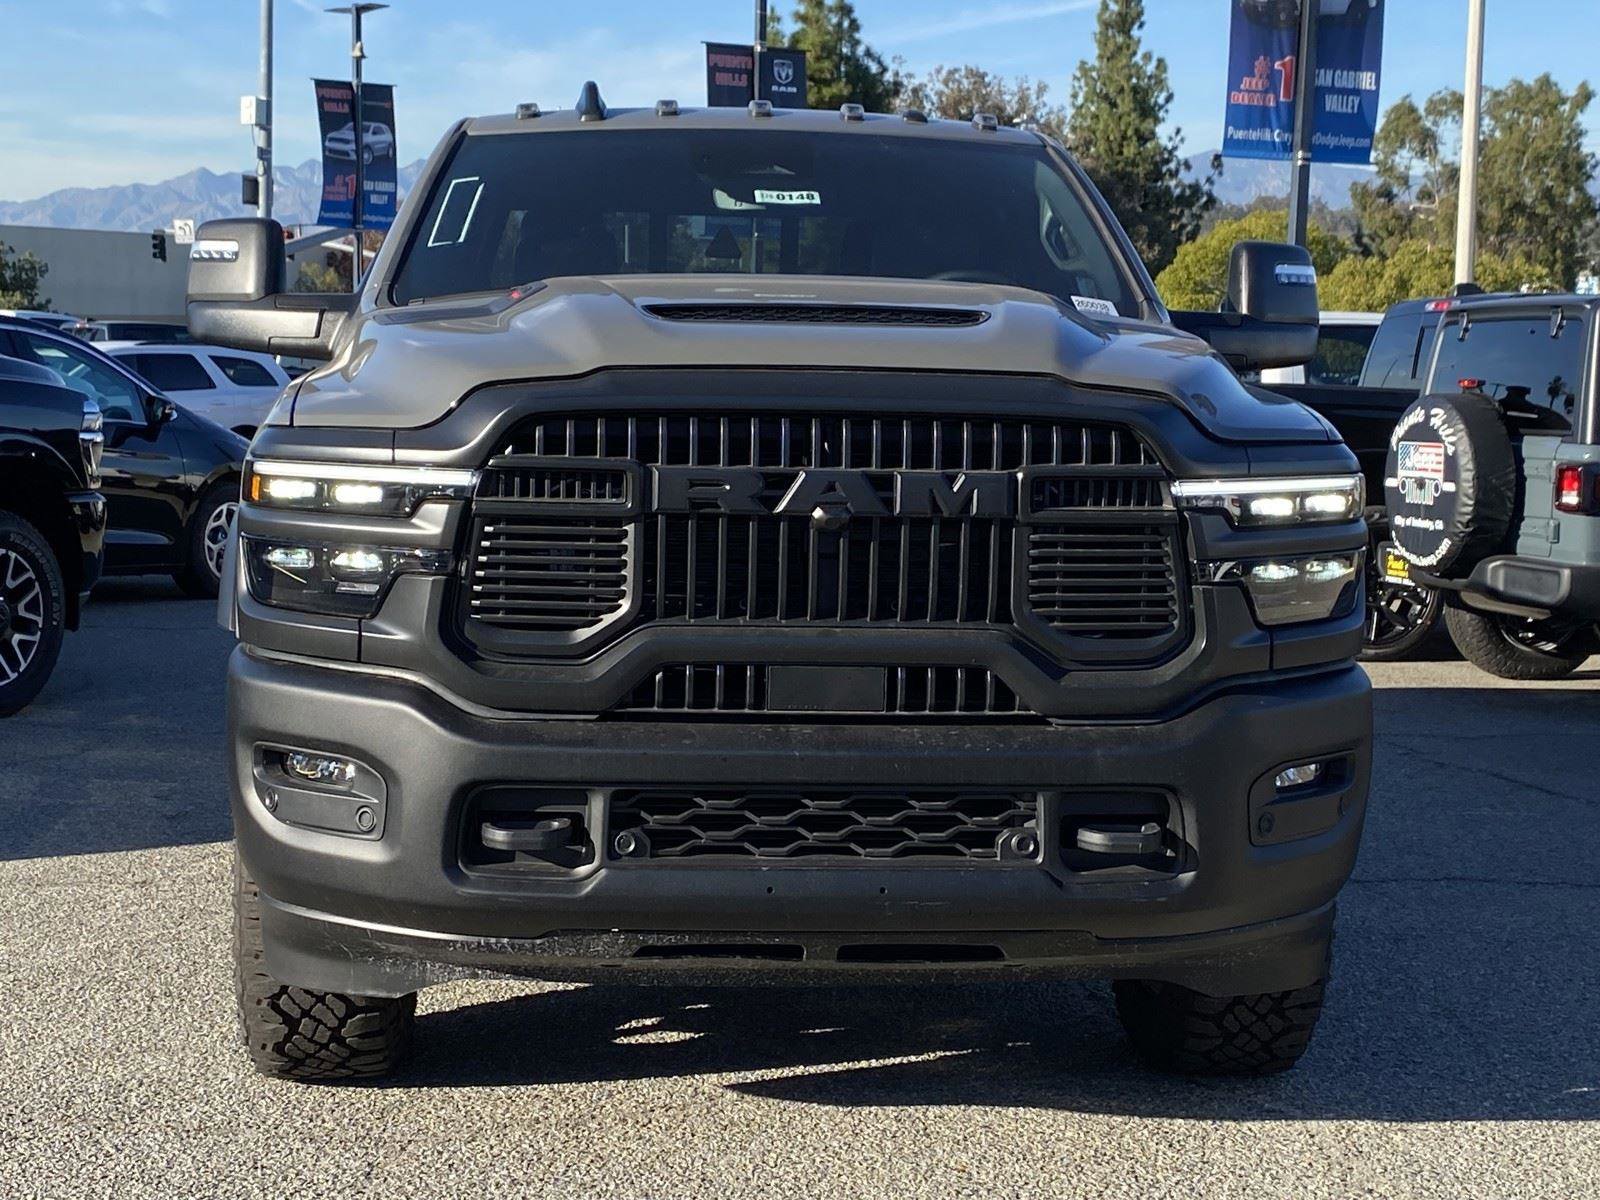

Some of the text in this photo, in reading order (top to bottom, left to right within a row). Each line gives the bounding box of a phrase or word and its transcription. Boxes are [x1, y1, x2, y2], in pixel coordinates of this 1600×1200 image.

[1334, 69, 1376, 91] GABRIEL
[1324, 94, 1361, 114] VALLEY
[776, 193, 815, 201] 0148
[652, 470, 1013, 516] RAM
